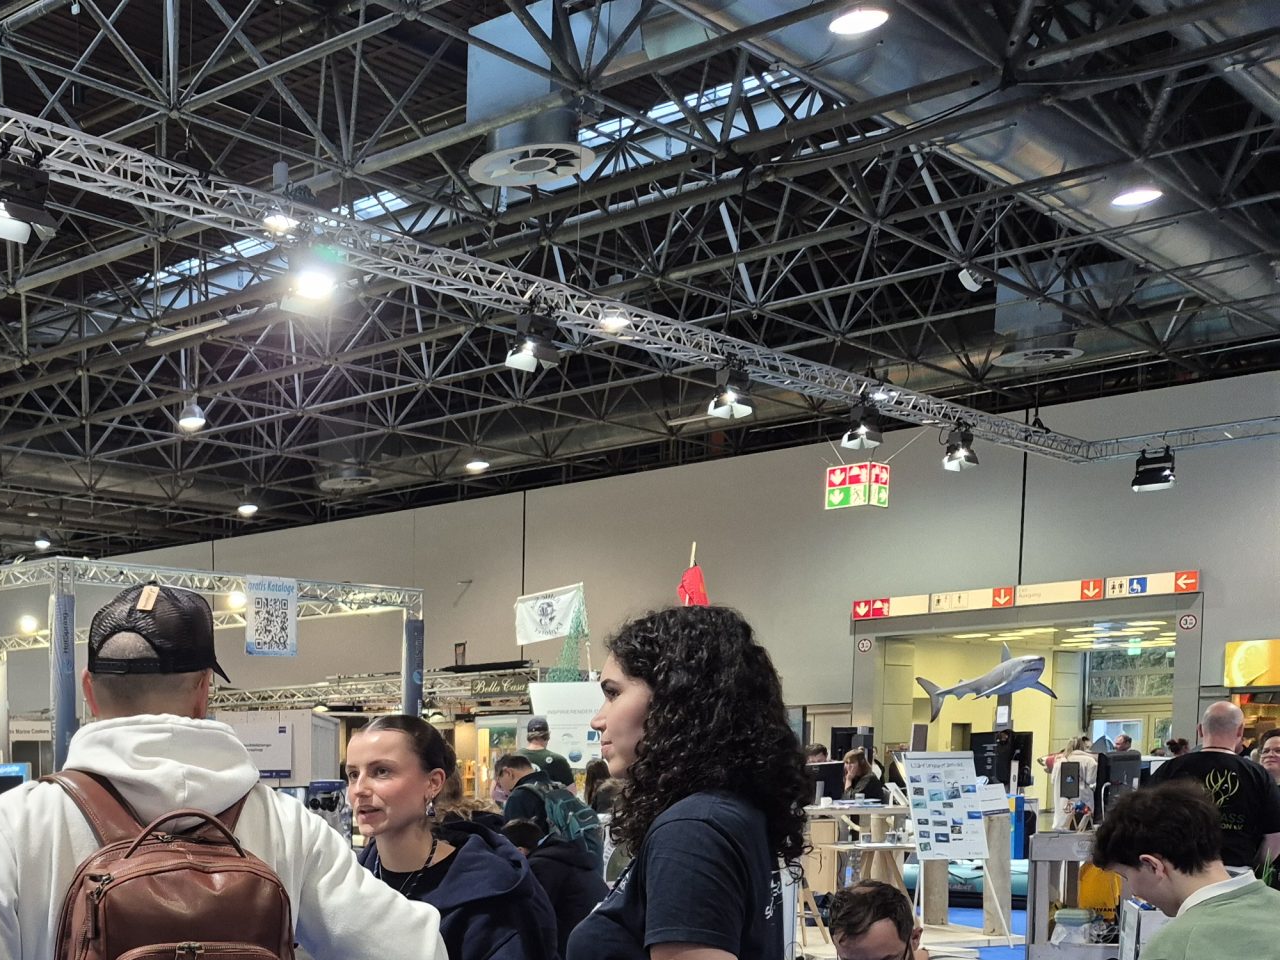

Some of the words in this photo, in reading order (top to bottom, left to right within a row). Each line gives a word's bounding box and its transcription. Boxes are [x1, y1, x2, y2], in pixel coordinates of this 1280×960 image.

[267, 581, 295, 595] Kataloge
[472, 680, 500, 694] Bella
[501, 679, 526, 692] Casa
